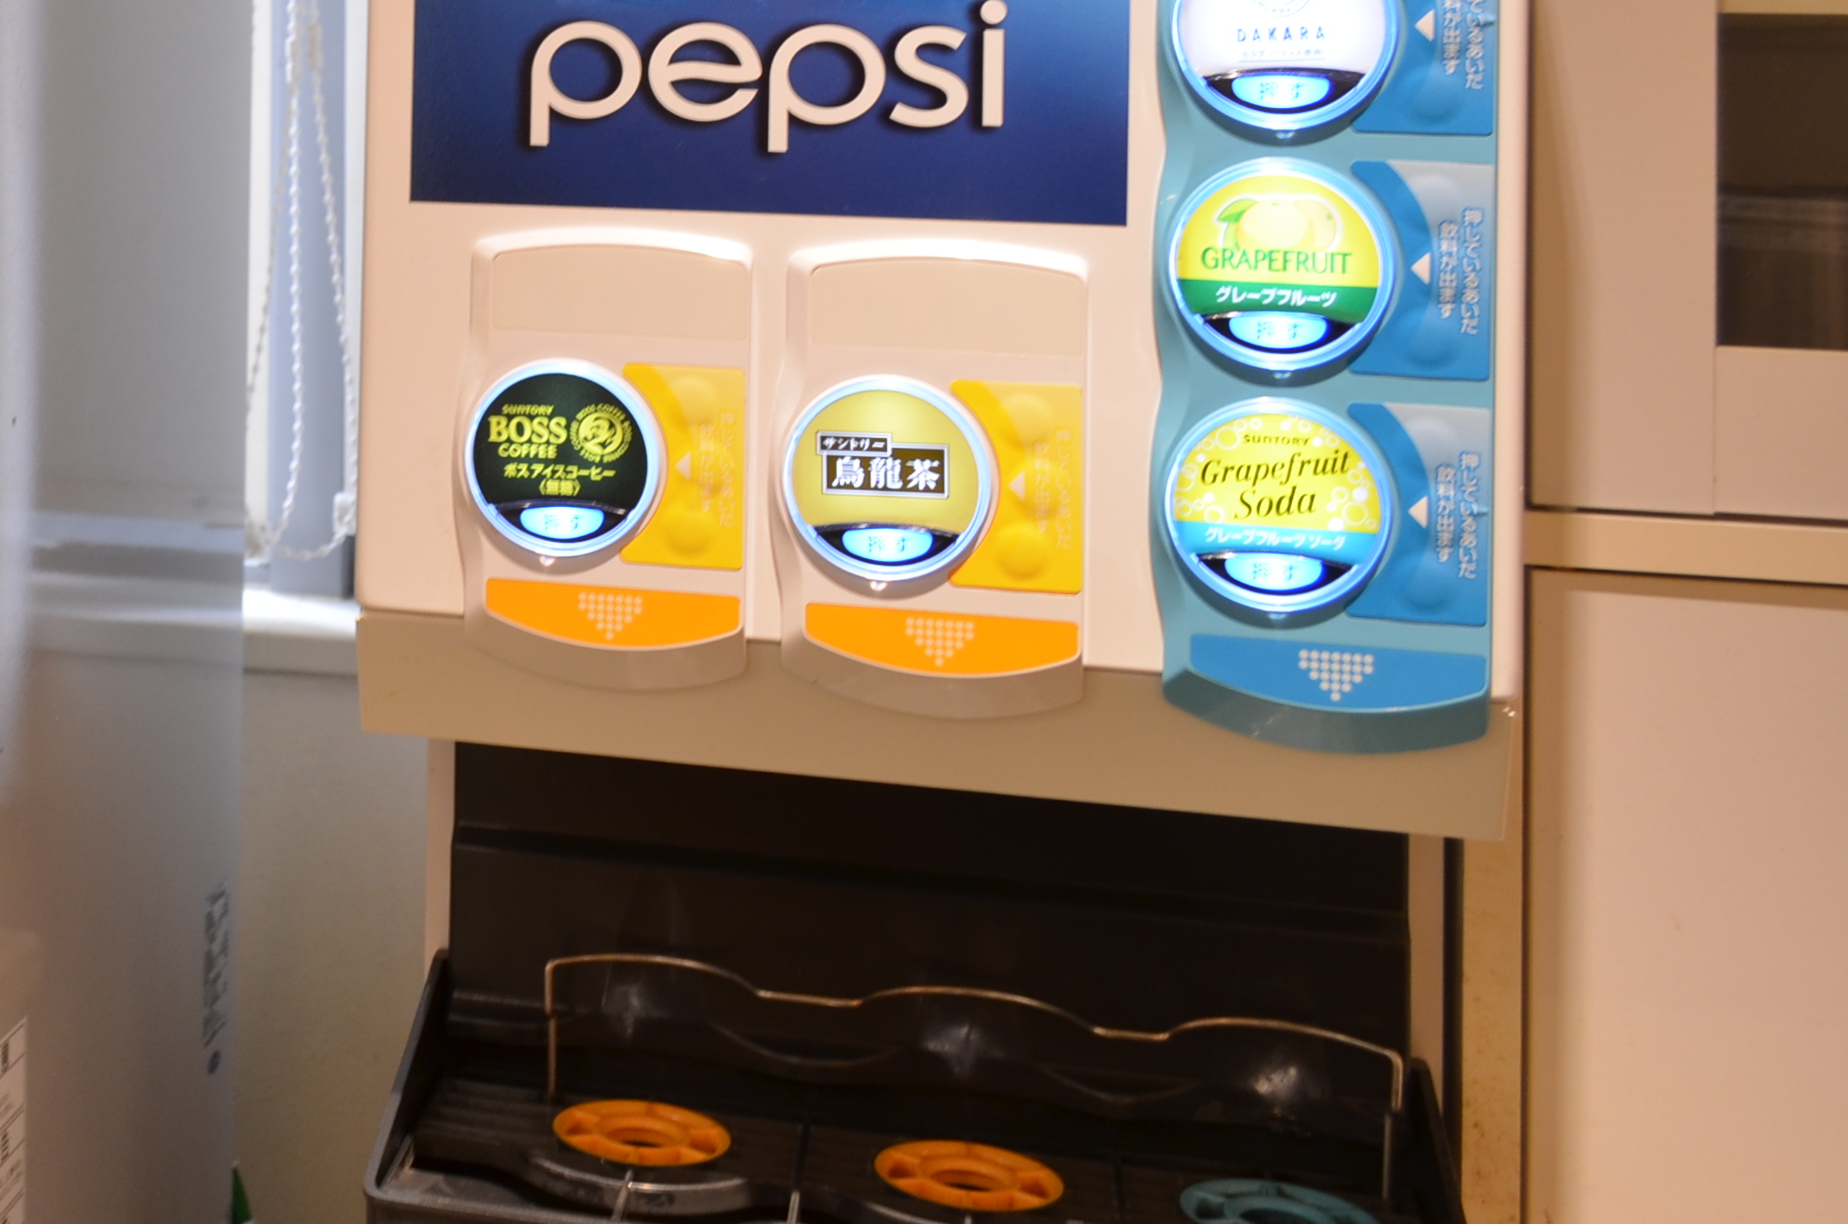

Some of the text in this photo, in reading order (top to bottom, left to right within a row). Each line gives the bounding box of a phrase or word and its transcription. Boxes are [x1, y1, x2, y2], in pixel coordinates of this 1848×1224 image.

[1237, 26, 1325, 42] DAKARA
[1201, 246, 1352, 274] GRAPEFRUIT
[1215, 286, 1337, 307] グレープフルーツ
[502, 404, 554, 416] SUNTORY
[488, 416, 567, 444] BOSS
[822, 436, 886, 451] サントリー
[1243, 435, 1310, 447] SUNTORY
[498, 444, 557, 458] COFFEE
[504, 463, 615, 480] ボスアイスコーヒー
[832, 457, 940, 490] 烏龍茶
[1201, 450, 1352, 486] Grapefruit
[1234, 486, 1316, 520] Soda
